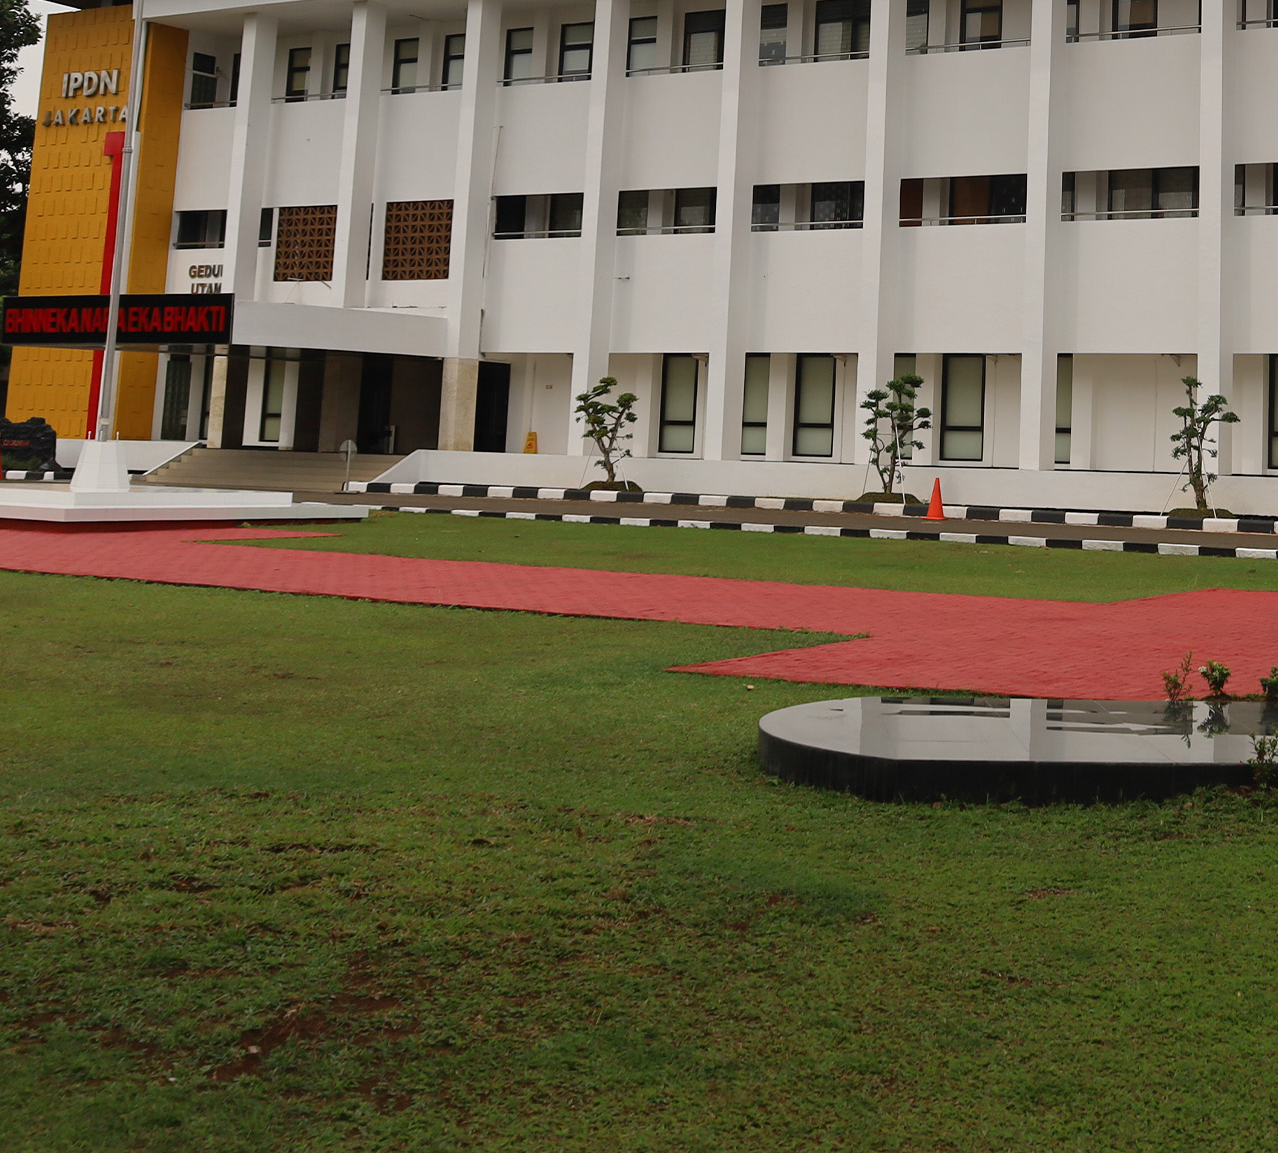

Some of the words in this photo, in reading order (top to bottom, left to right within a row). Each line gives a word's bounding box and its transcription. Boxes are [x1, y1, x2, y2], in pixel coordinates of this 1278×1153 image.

[61, 69, 119, 98] IPDN
[42, 104, 128, 127] JAKARTA
[5, 308, 79, 334] BHINNEKA
[128, 307, 162, 333] EKA
[163, 306, 226, 333] BHAKTI
